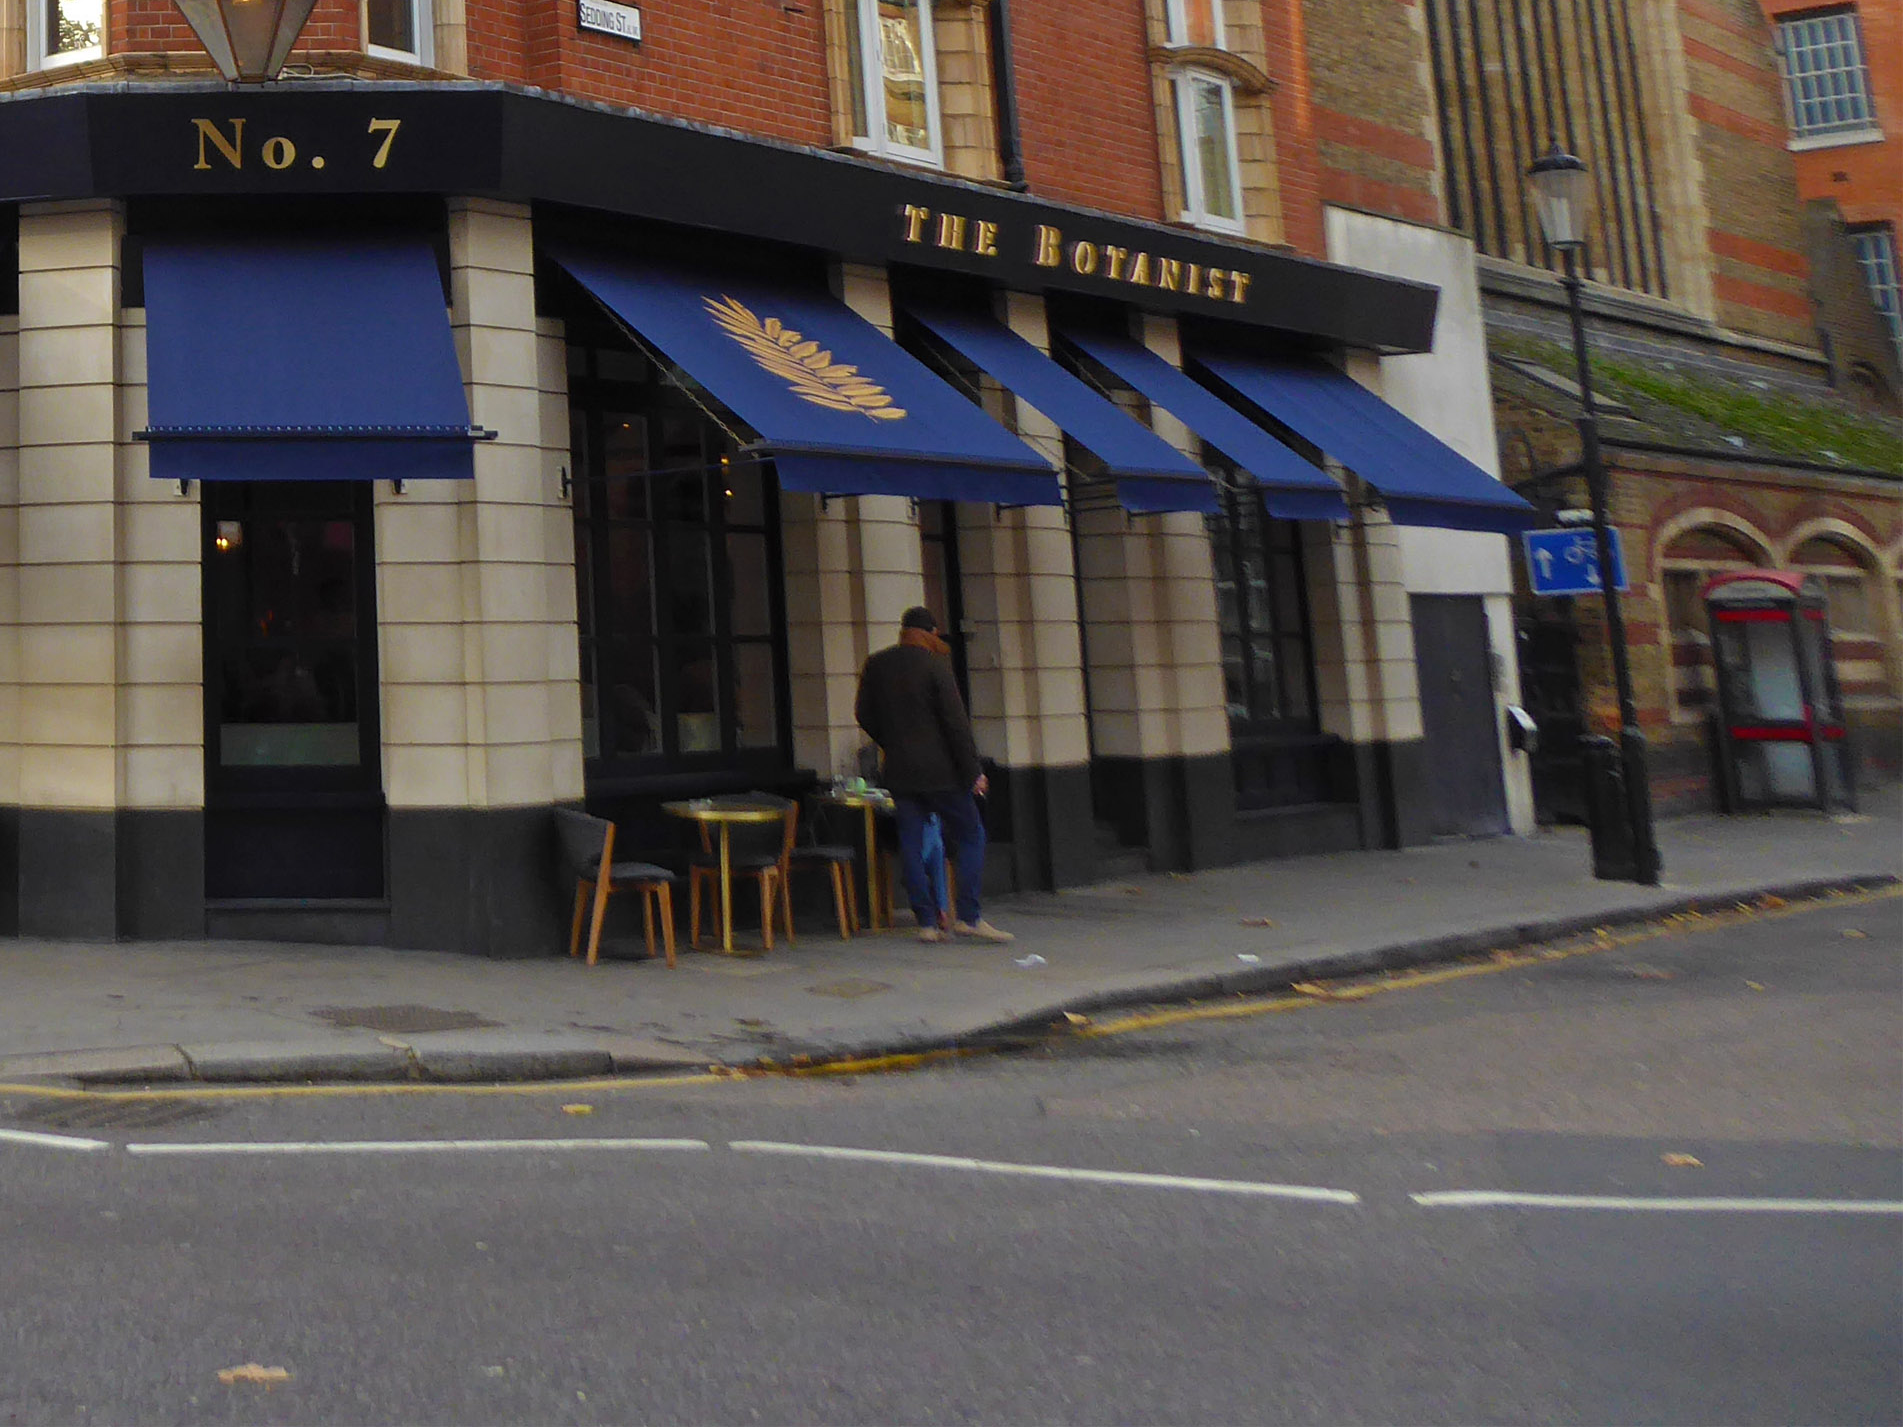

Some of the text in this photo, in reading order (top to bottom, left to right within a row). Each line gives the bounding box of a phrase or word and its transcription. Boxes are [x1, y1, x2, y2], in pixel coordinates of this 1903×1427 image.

[580, 3, 614, 30] SEDDING
[191, 117, 401, 169] No. 7
[902, 203, 1251, 304] THE BOTANIST
